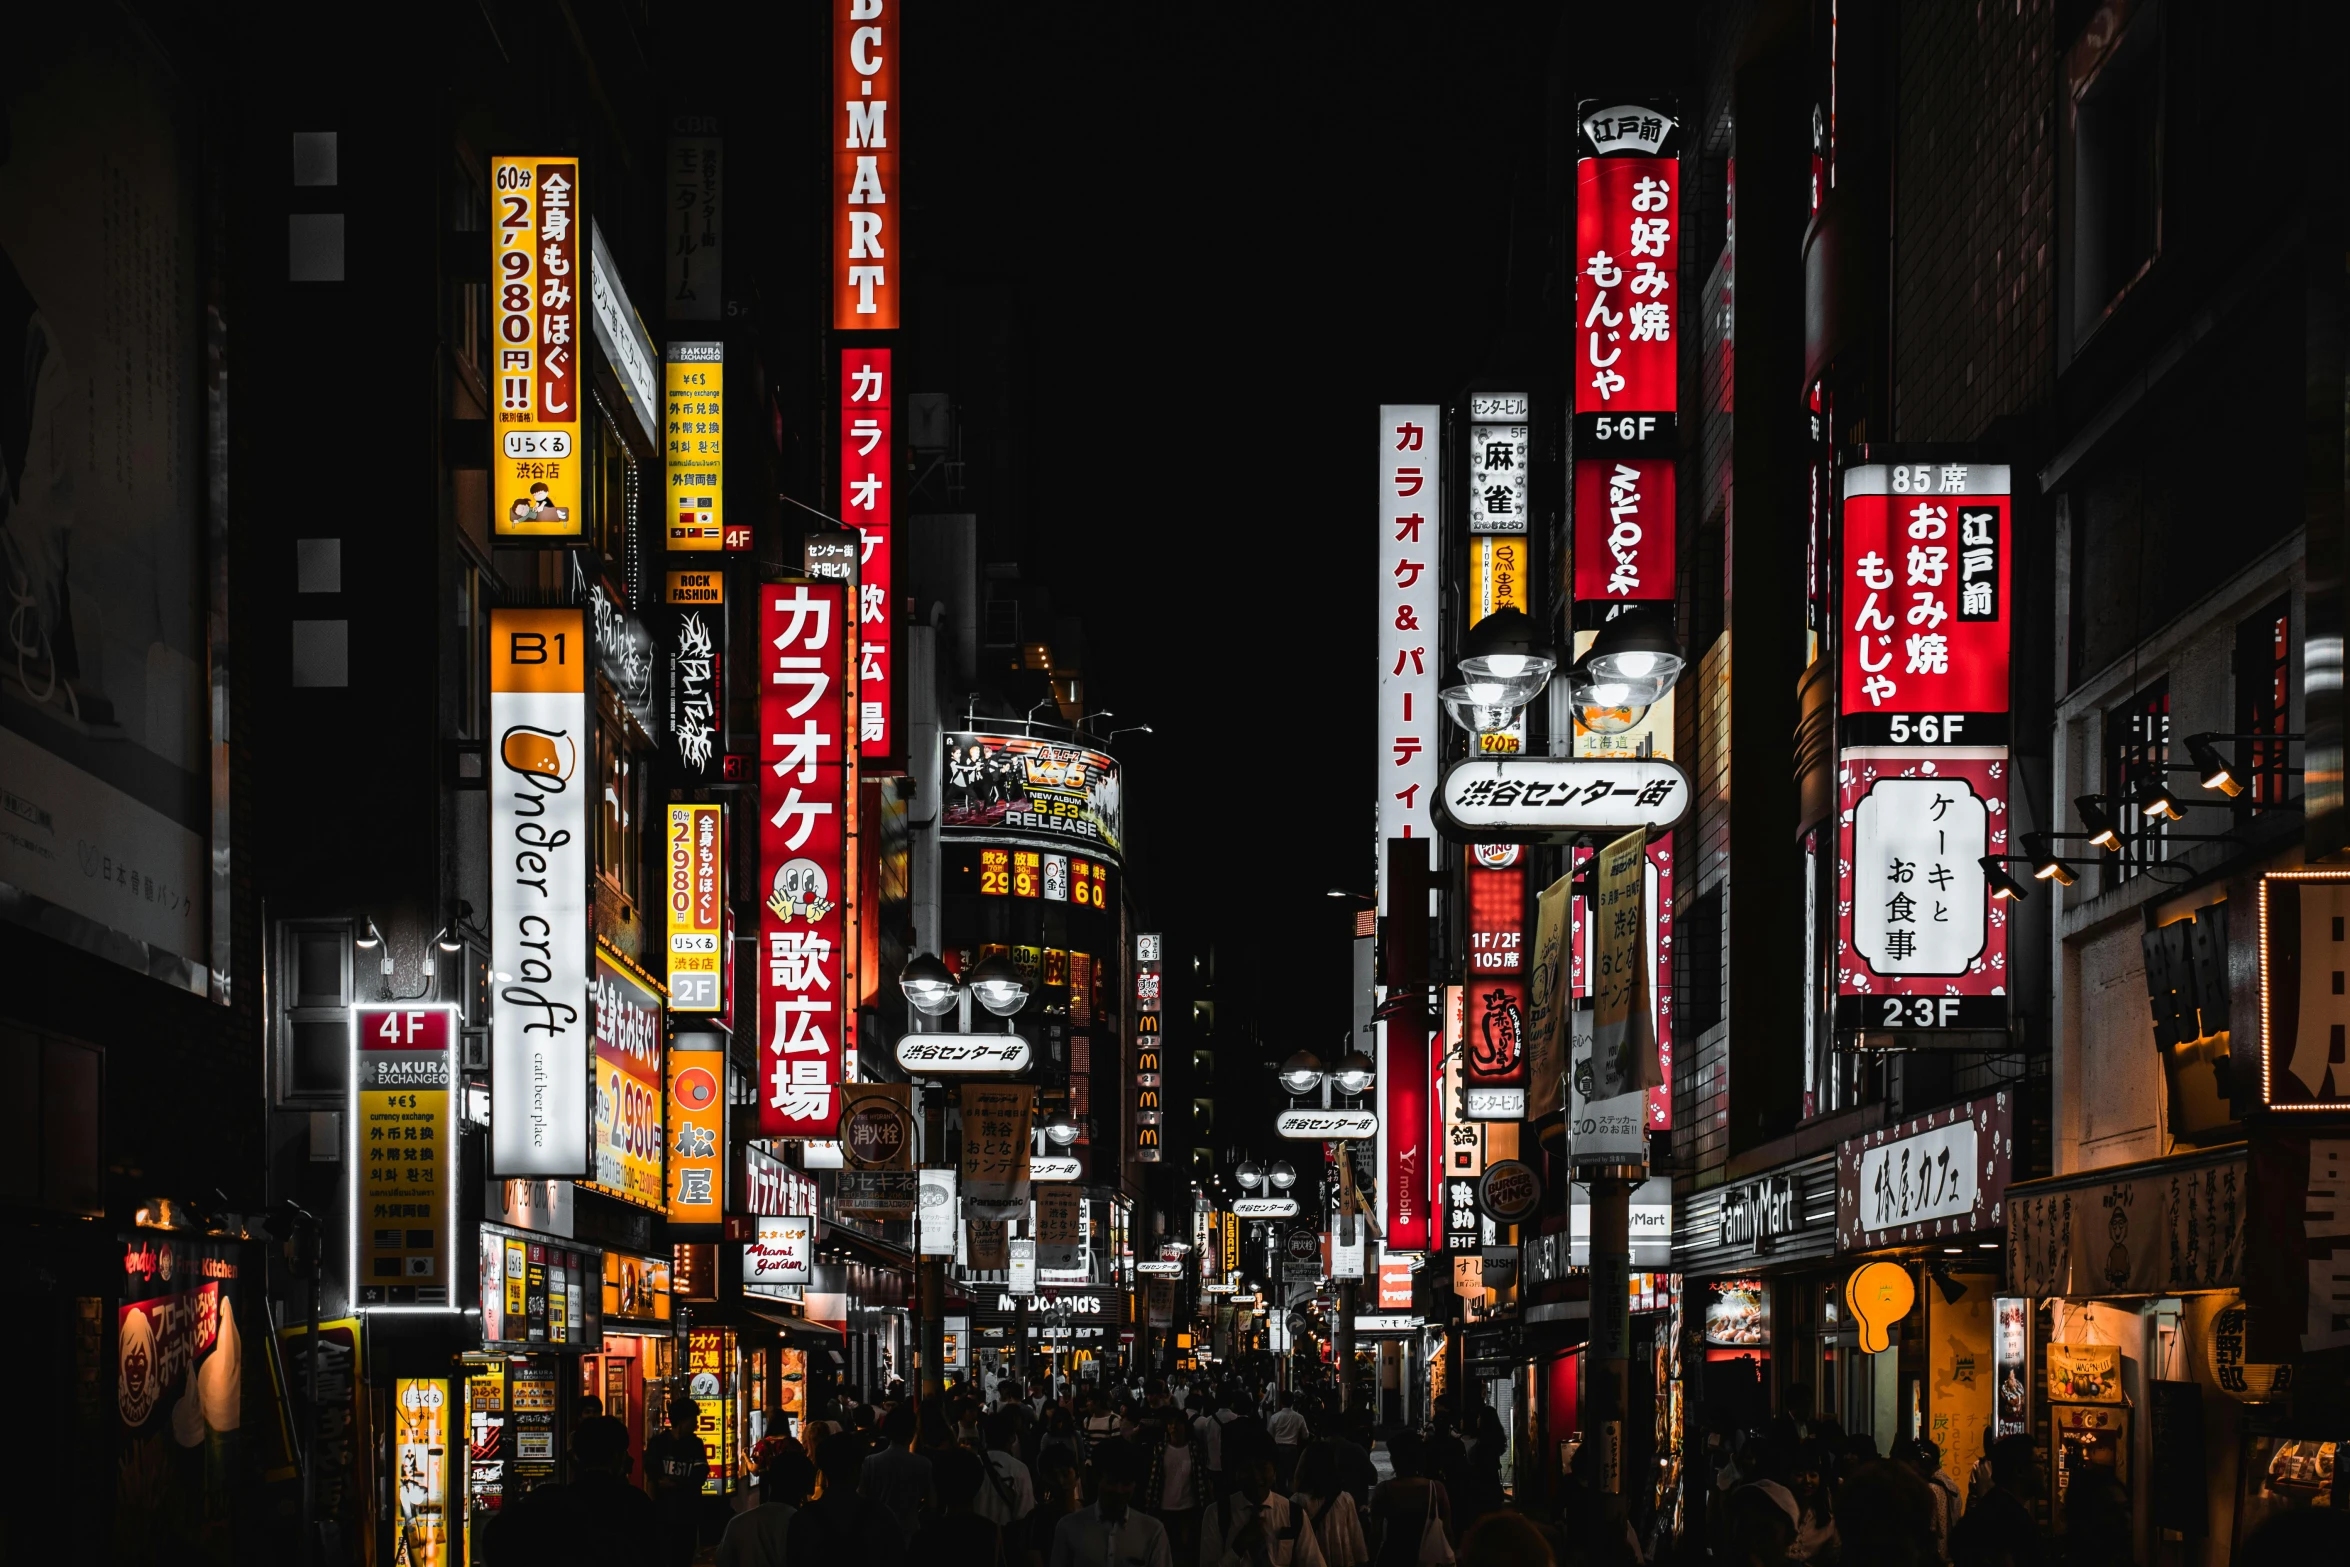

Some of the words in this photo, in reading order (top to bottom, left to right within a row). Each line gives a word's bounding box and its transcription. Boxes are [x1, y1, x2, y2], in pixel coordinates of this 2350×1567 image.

[1593, 116, 1662, 143] 江戸前
[1629, 176, 1671, 342] お好み焼
[540, 173, 572, 415] 全身もみほぐし
[1585, 250, 1626, 401] もんじゃ
[681, 347, 721, 356] SAKURA
[1472, 399, 1528, 416] センタービル
[1510, 427, 1528, 439] 5F
[508, 436, 566, 454] りらくる
[515, 461, 561, 480] 渋谷店
[672, 473, 718, 487] 外貨両替
[1484, 441, 1515, 515] 麻雀
[1892, 463, 1968, 494] 85席
[725, 530, 750, 548] 4F
[807, 544, 854, 559] センター街
[1961, 512, 1994, 616] 江戸前
[680, 575, 711, 587] ROCK
[1905, 502, 1949, 676] お好み焼
[672, 588, 718, 600] FASHION
[1855, 551, 1897, 707] もんじゃ
[510, 632, 566, 665] B1
[771, 587, 832, 852] カラオケ
[1583, 736, 1628, 749] 北海道
[1029, 791, 1052, 800] NEW
[1052, 795, 1082, 806] ALBUM
[1455, 779, 1678, 807] 渋谷センター街
[1033, 799, 1079, 819] 5.23
[1005, 810, 1097, 838] RELEASE
[1927, 793, 1955, 922] ケーキと
[698, 814, 714, 925] 全身もみほぐし
[1885, 857, 1918, 961] お食事
[1613, 907, 1638, 940] 渋谷
[674, 937, 714, 950] りらくる
[674, 956, 715, 970] 渋谷店
[1473, 952, 1520, 969] 105席
[501, 915, 578, 1038] craft
[678, 978, 712, 1001] 2F
[379, 1011, 426, 1044] 4F
[596, 974, 660, 1072] 全身もみほぐし
[770, 930, 832, 1121] 歌広場
[902, 1044, 1024, 1061] 渋谷センター街
[378, 1061, 449, 1074] SAKURA
[533, 1052, 548, 1083] craft
[533, 1084, 548, 1112] beer
[370, 1112, 400, 1123] currency
[401, 1112, 435, 1123] exchange
[1283, 1118, 1374, 1130] 渋谷センター街
[1599, 1115, 1638, 1125] ステッカー
[531, 1114, 548, 1148] place
[852, 1123, 900, 1146] 消火栓
[982, 1121, 1014, 1138] 渋谷
[1450, 1125, 1478, 1147] 鍋
[966, 1139, 1027, 1156] おとなり
[674, 1122, 716, 1205] 松屋
[966, 1159, 1027, 1174] サンデー
[370, 1168, 398, 1183] 외화
[406, 1168, 435, 1183] 환전
[1487, 1173, 1531, 1196] BURGER
[969, 1196, 1024, 1207] Panasonic
[1450, 1181, 1476, 1230] 米助
[1489, 1184, 1533, 1209] KING
[373, 1203, 431, 1218] 外貨両替
[1718, 1179, 1793, 1256] FamilyMart
[757, 1229, 807, 1241] スタとピザ
[1290, 1240, 1314, 1251] 消火栓
[1449, 1236, 1477, 1249] B1F
[745, 1243, 795, 1258] Miami
[202, 1257, 238, 1280] Kitchen
